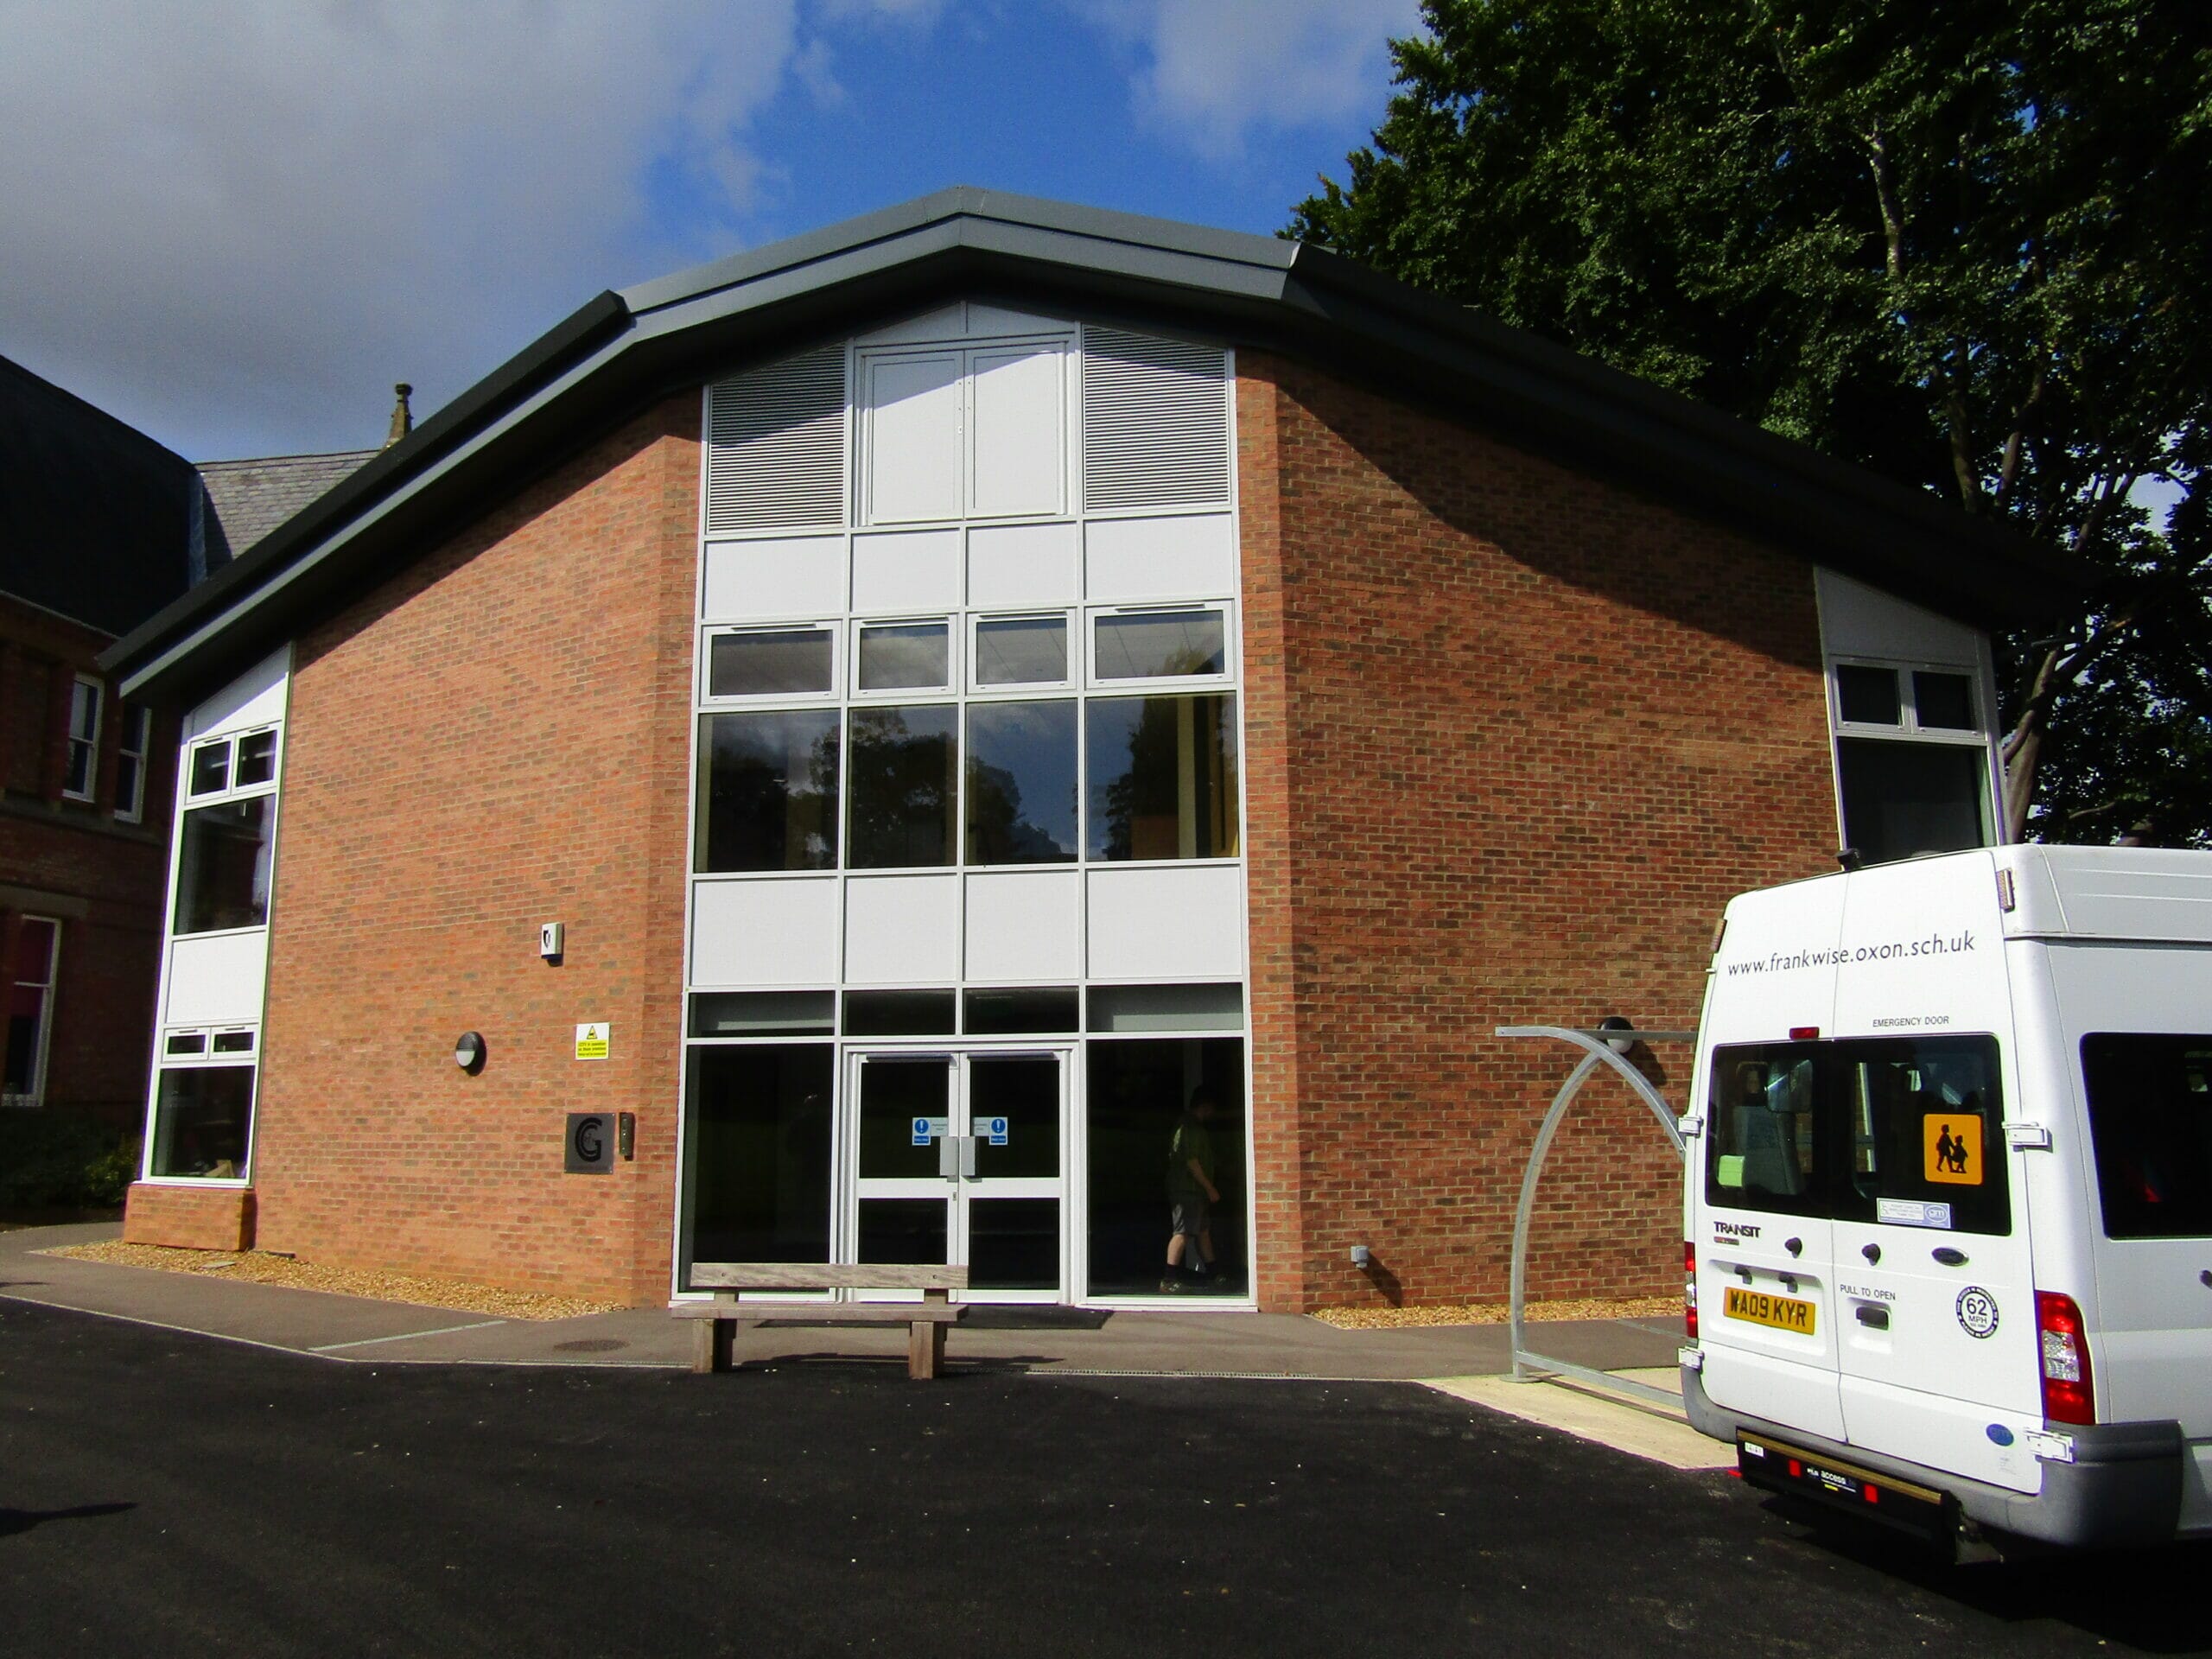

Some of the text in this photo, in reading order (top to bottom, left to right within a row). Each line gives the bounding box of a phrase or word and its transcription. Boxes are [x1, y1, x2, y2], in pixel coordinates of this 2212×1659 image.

[1728, 930, 1975, 976] www.frankwise.oxon.sch.uk
[1872, 1015, 1950, 1027] EMERGENCY DOOR
[1713, 1221, 1761, 1238] TRANSIT
[1840, 1284, 1897, 1301] PULL TO OPEN
[1730, 1290, 1808, 1327] WA09 KYR
[1967, 1298, 1987, 1316] 62
[1968, 1315, 1987, 1325] MPH
